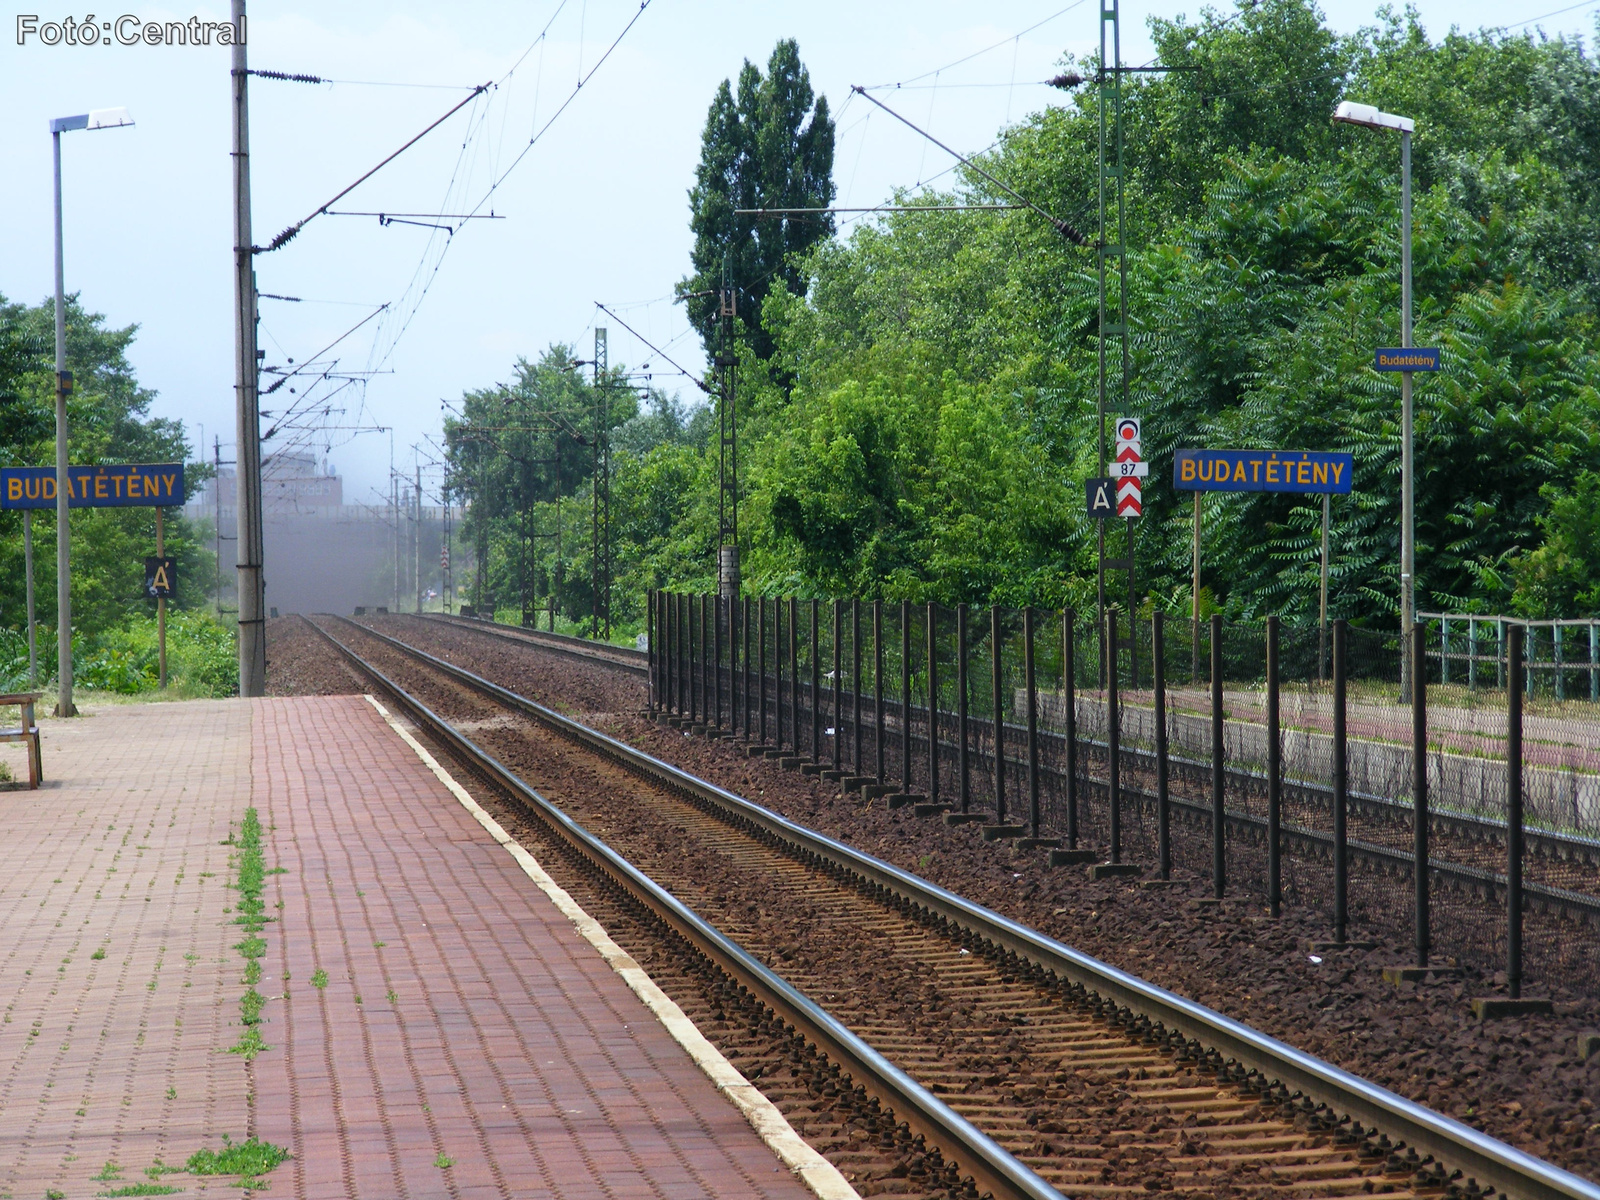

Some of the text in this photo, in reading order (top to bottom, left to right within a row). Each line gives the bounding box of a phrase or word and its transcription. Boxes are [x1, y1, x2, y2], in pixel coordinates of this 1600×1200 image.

[1379, 354, 1436, 368] Budatétény
[1121, 463, 1136, 476] 87
[1181, 453, 1345, 485] BUDATÉTÉNY
[1093, 482, 1110, 510] Á
[152, 561, 170, 590] Á
